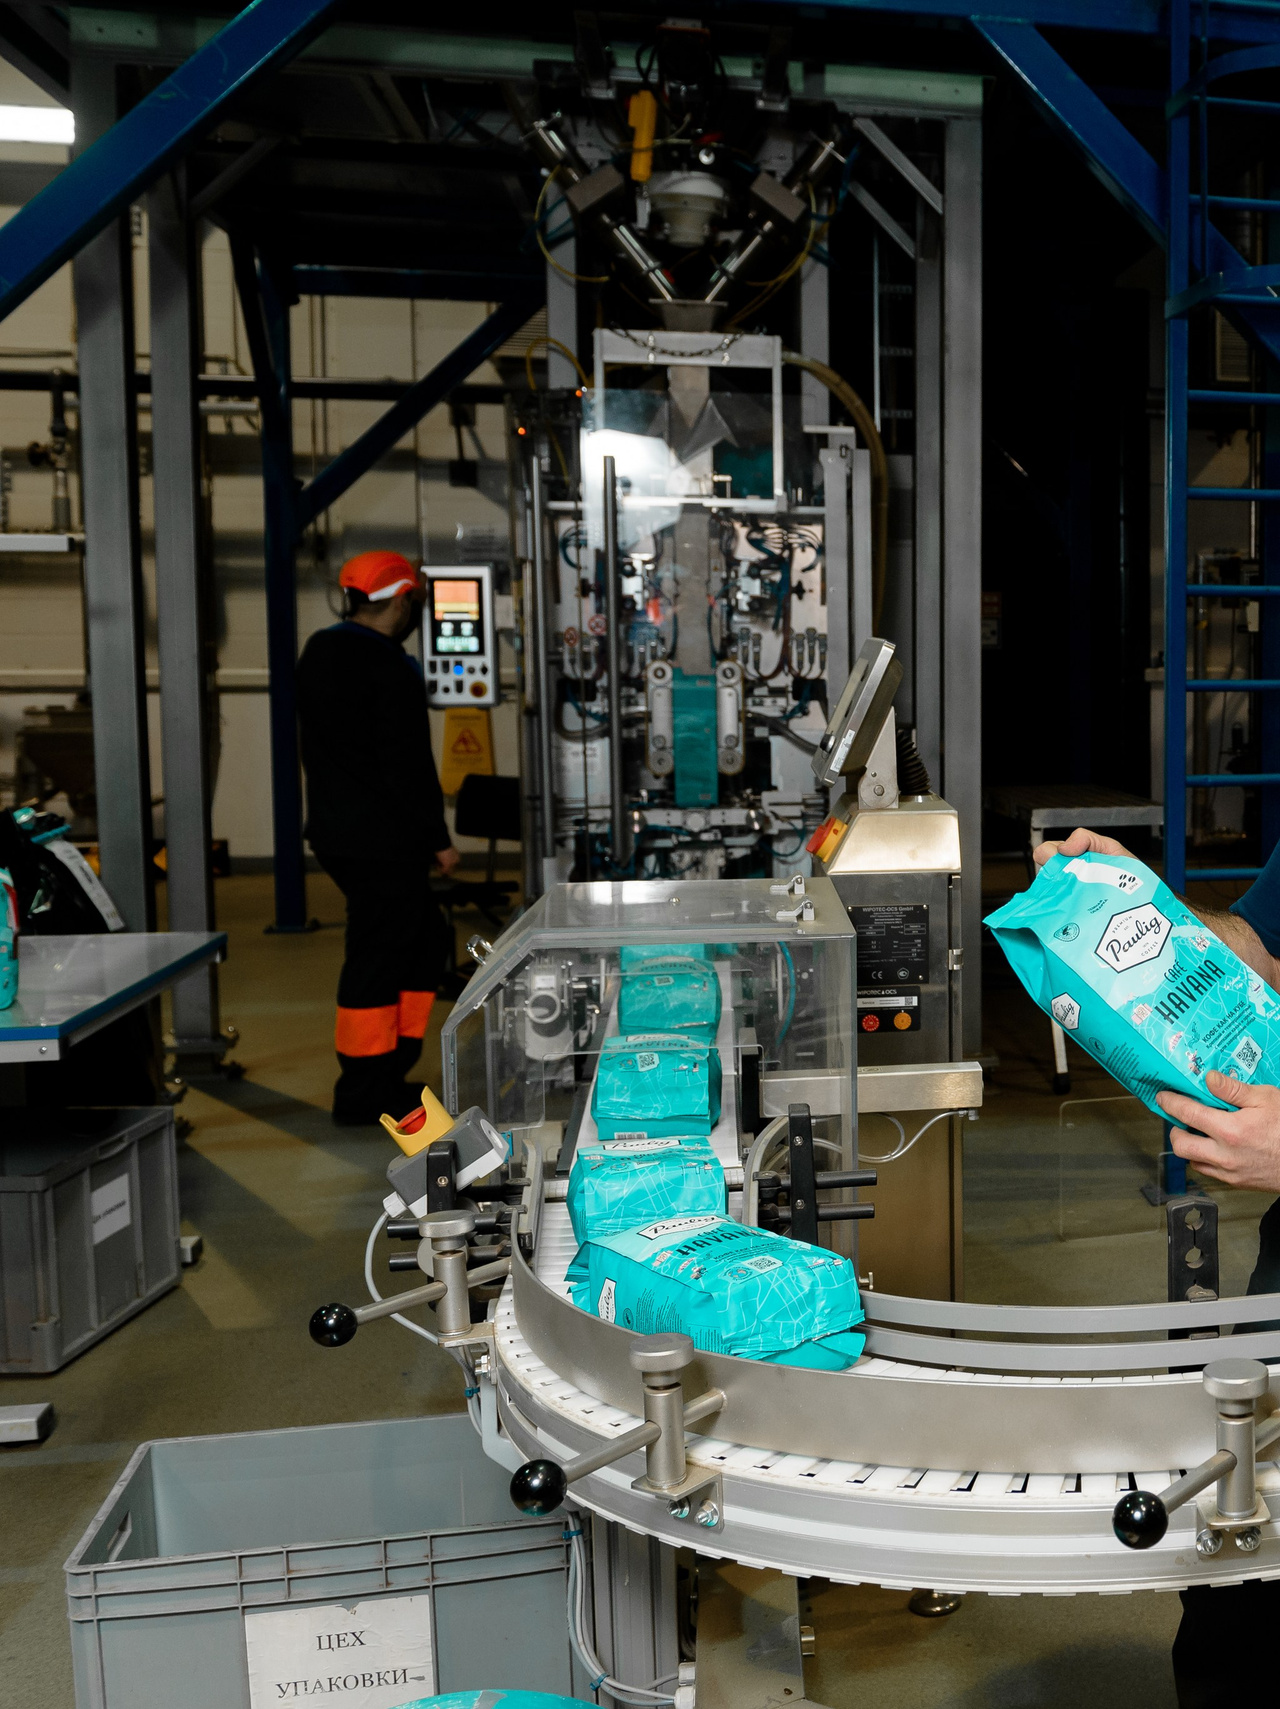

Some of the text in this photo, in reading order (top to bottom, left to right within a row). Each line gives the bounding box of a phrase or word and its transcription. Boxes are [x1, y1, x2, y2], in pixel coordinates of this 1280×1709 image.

[1105, 916, 1163, 962] Paulig
[1164, 959, 1188, 984] CAFÉ
[1154, 959, 1226, 1025] HAVANA
[1202, 1026, 1218, 1043] КОФЕ
[1216, 1016, 1229, 1030] КАК
[648, 1217, 715, 1235] Paulig
[316, 1630, 366, 1652] ЦЕХ
[275, 1668, 409, 1699] УПАКОВКИ
